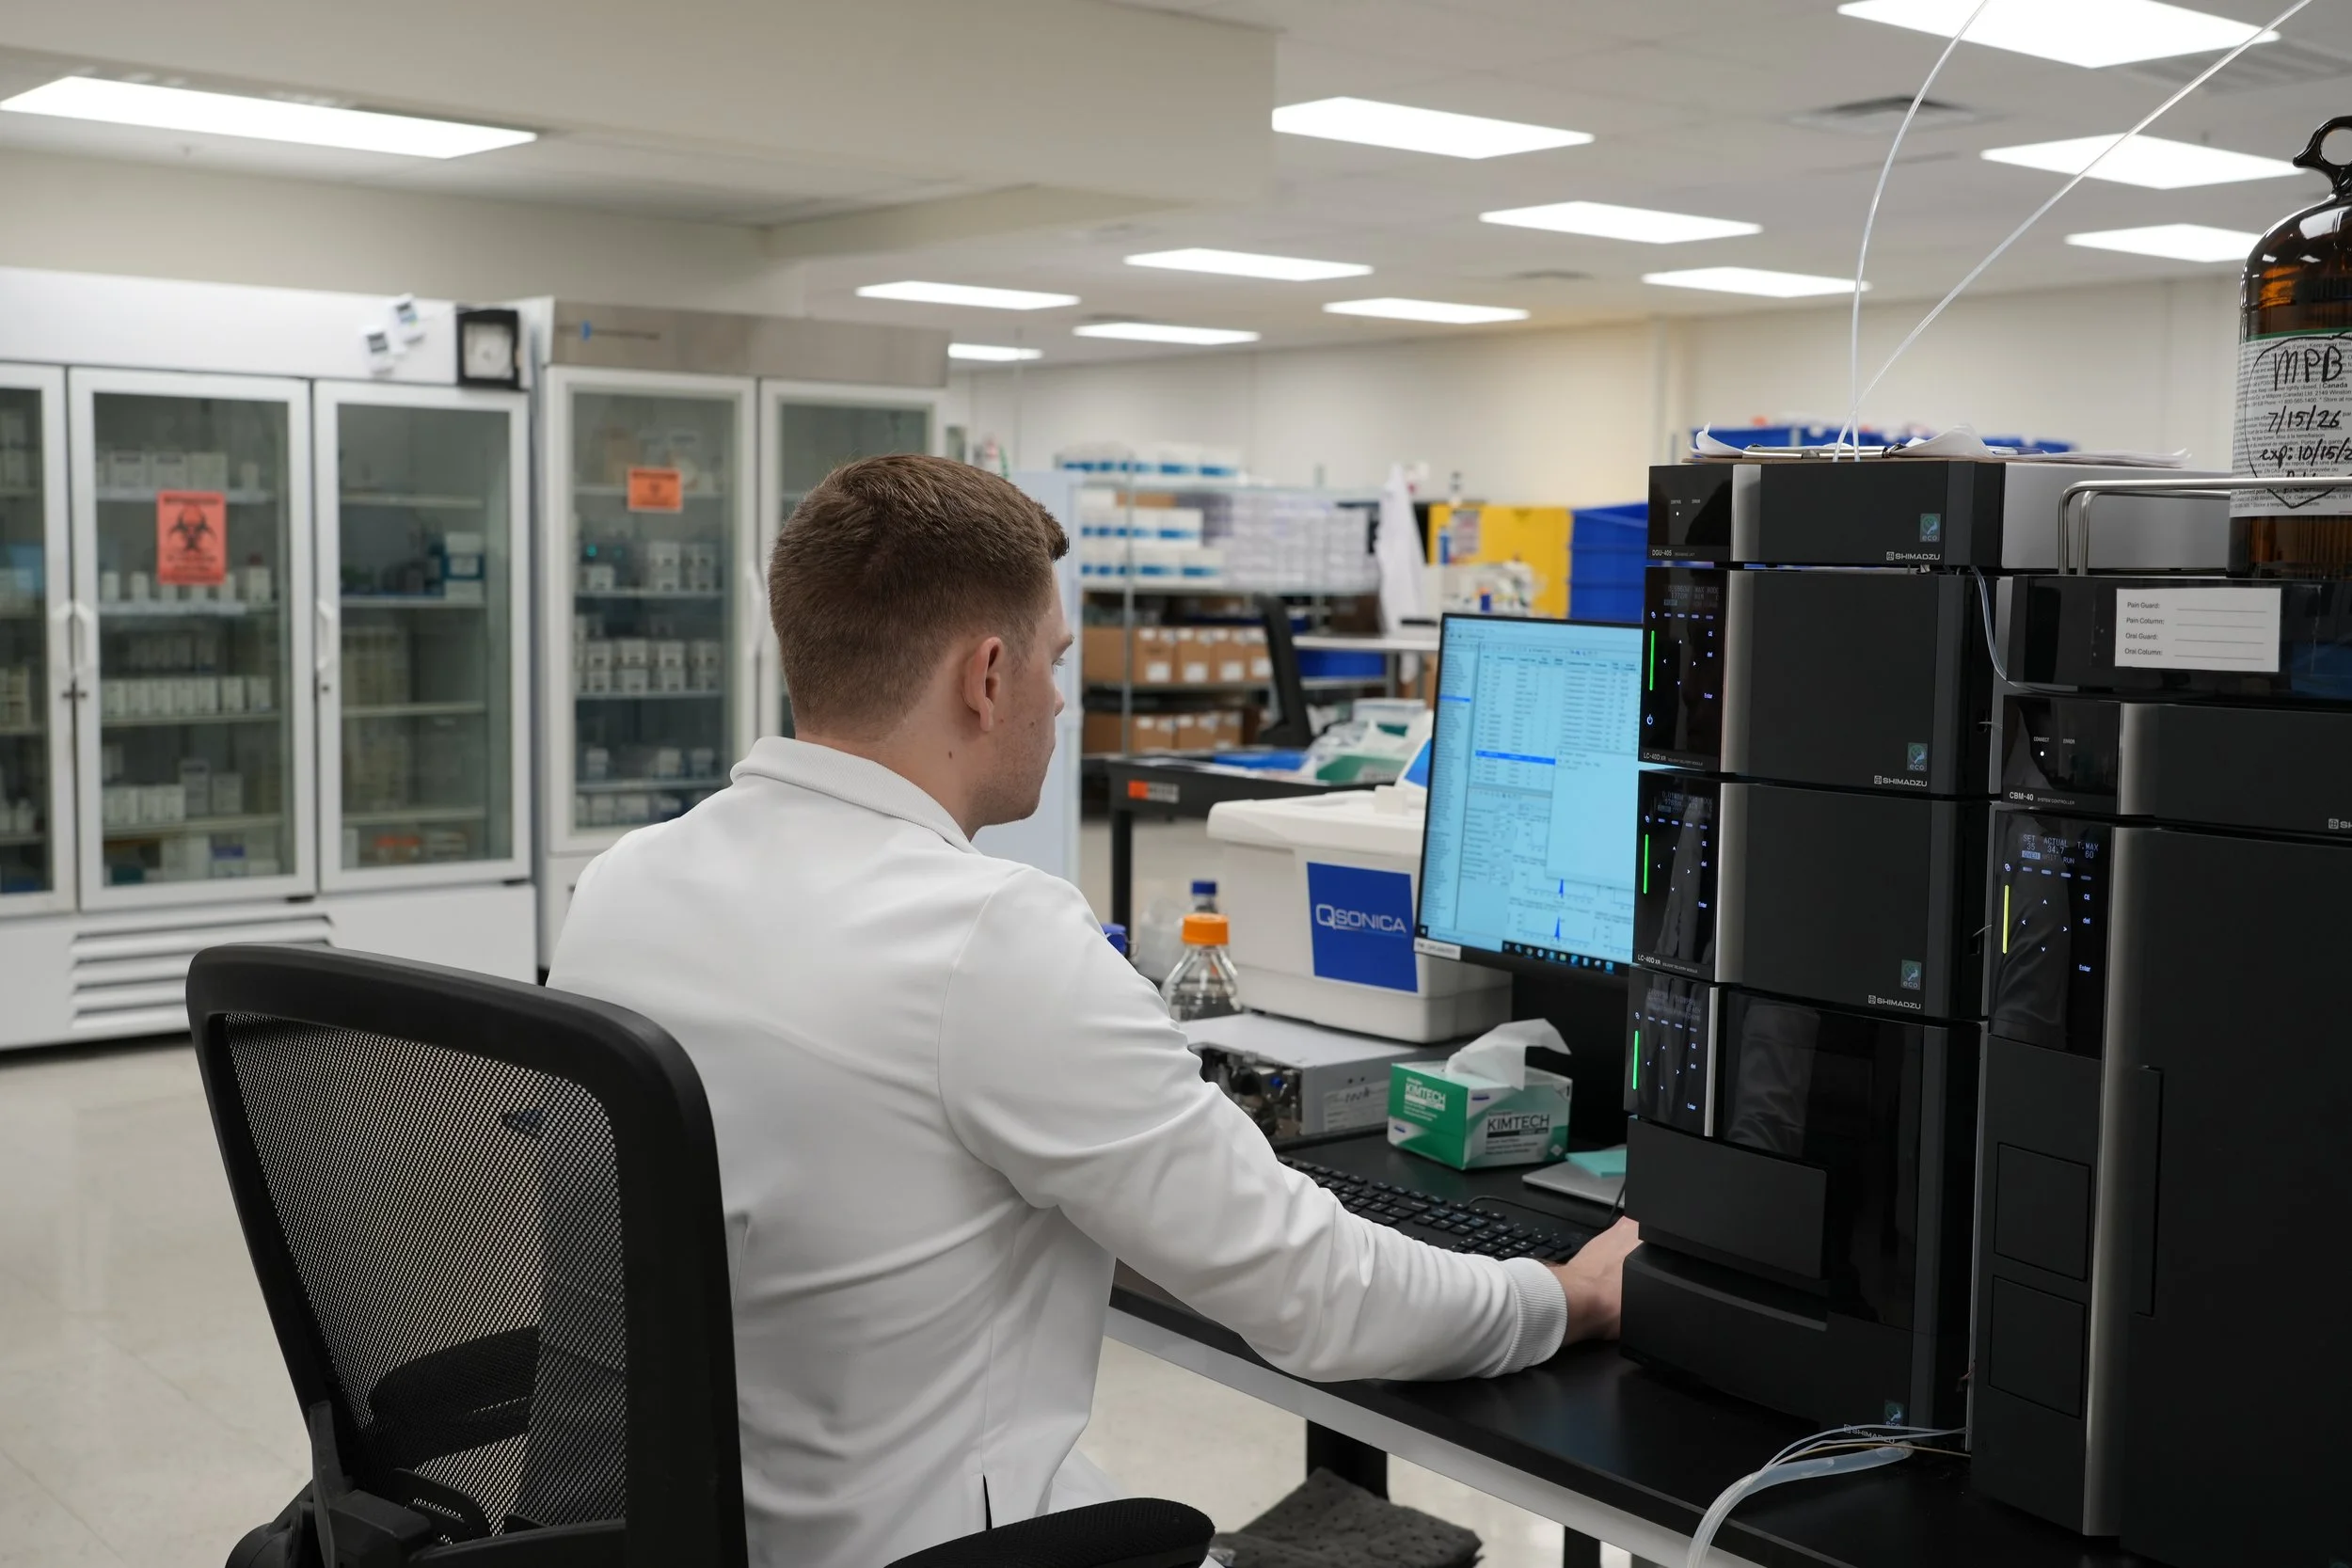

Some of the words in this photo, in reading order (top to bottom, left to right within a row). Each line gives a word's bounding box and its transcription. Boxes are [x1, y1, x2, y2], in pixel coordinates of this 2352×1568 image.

[2274, 346, 2343, 391] MPB
[2268, 405, 2341, 434] 7/15/26
[2260, 445, 2293, 468] exp:
[1883, 777, 1927, 787] SHIMADZU
[2009, 792, 2034, 801] CBM-40
[2026, 842, 2036, 851] 35
[2047, 846, 2065, 855] 34.7
[2043, 837, 2069, 847] ACTUAL
[1316, 904, 1406, 934] QSONICA
[1637, 954, 1655, 964] LC-40D
[1876, 997, 1921, 1010] SHIMADZU
[1405, 1084, 1446, 1103] KIMTECH
[1486, 1114, 1550, 1131] KIMTECH
